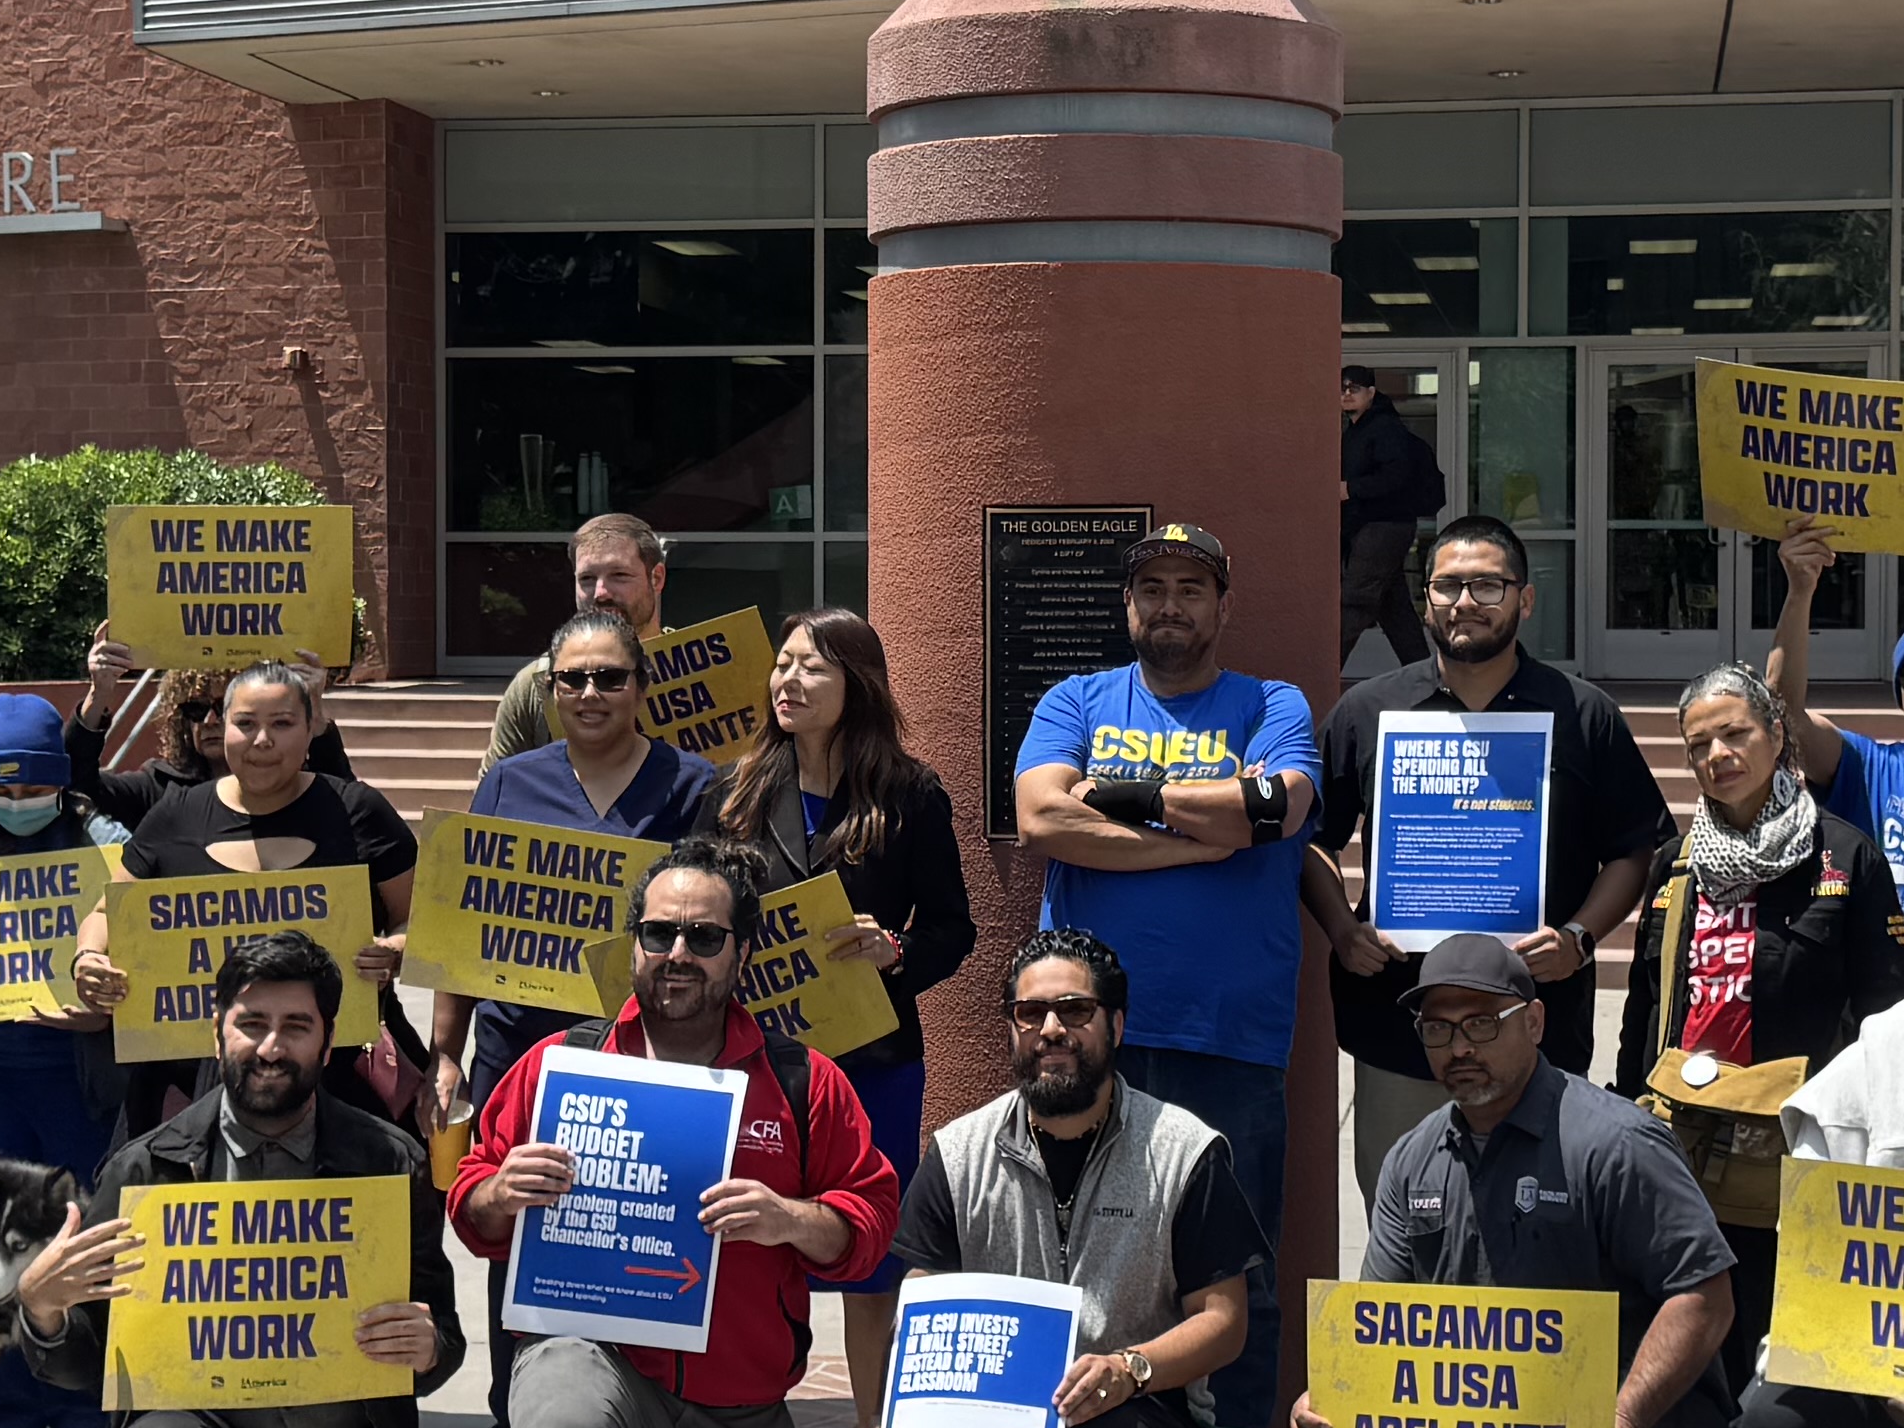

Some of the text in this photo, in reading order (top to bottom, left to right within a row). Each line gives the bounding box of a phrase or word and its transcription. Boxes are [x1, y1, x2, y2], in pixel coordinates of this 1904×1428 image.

[1736, 379, 1904, 432] WE MAKE
[1740, 426, 1897, 475] AMERICA
[776, 494, 794, 513] A
[1763, 472, 1870, 518] WORK
[150, 519, 312, 553] WE MAKE
[1000, 519, 1138, 532] THE GOLDEN EAGLE
[156, 561, 307, 594] AMERICA
[181, 603, 284, 636] WORK
[647, 681, 716, 721] USA
[1394, 740, 1490, 758] WHERE IS CSU
[1392, 758, 1488, 776] SPENDING ALL
[1392, 777, 1480, 795] THE MONEY?
[464, 828, 627, 888] WE MAKE
[149, 884, 328, 932] SACAMOS
[460, 876, 614, 933] AMERICA
[188, 938, 213, 974] A
[480, 924, 586, 974] WORK
[559, 1092, 629, 1127] CSU'S
[555, 1121, 644, 1160] BUDGET
[748, 1120, 782, 1140] CFA
[571, 1155, 669, 1195] ROBLEM:
[162, 1196, 354, 1248] WE MAKE
[543, 1206, 617, 1232] by the CSU
[558, 1193, 676, 1222] problem created
[541, 1226, 676, 1258] Chancellor's Office.
[161, 1253, 350, 1303] AMERICA
[187, 1313, 317, 1361] WORK
[909, 1312, 1019, 1338] THE CSU INVESTS
[1354, 1301, 1564, 1355] SACAMOS
[904, 1335, 918, 1355] IN
[919, 1333, 953, 1353] WALL
[901, 1352, 1005, 1375] INSTEAD OF THE
[898, 1372, 978, 1393] CLASSROOM
[1392, 1358, 1519, 1411] A USA
